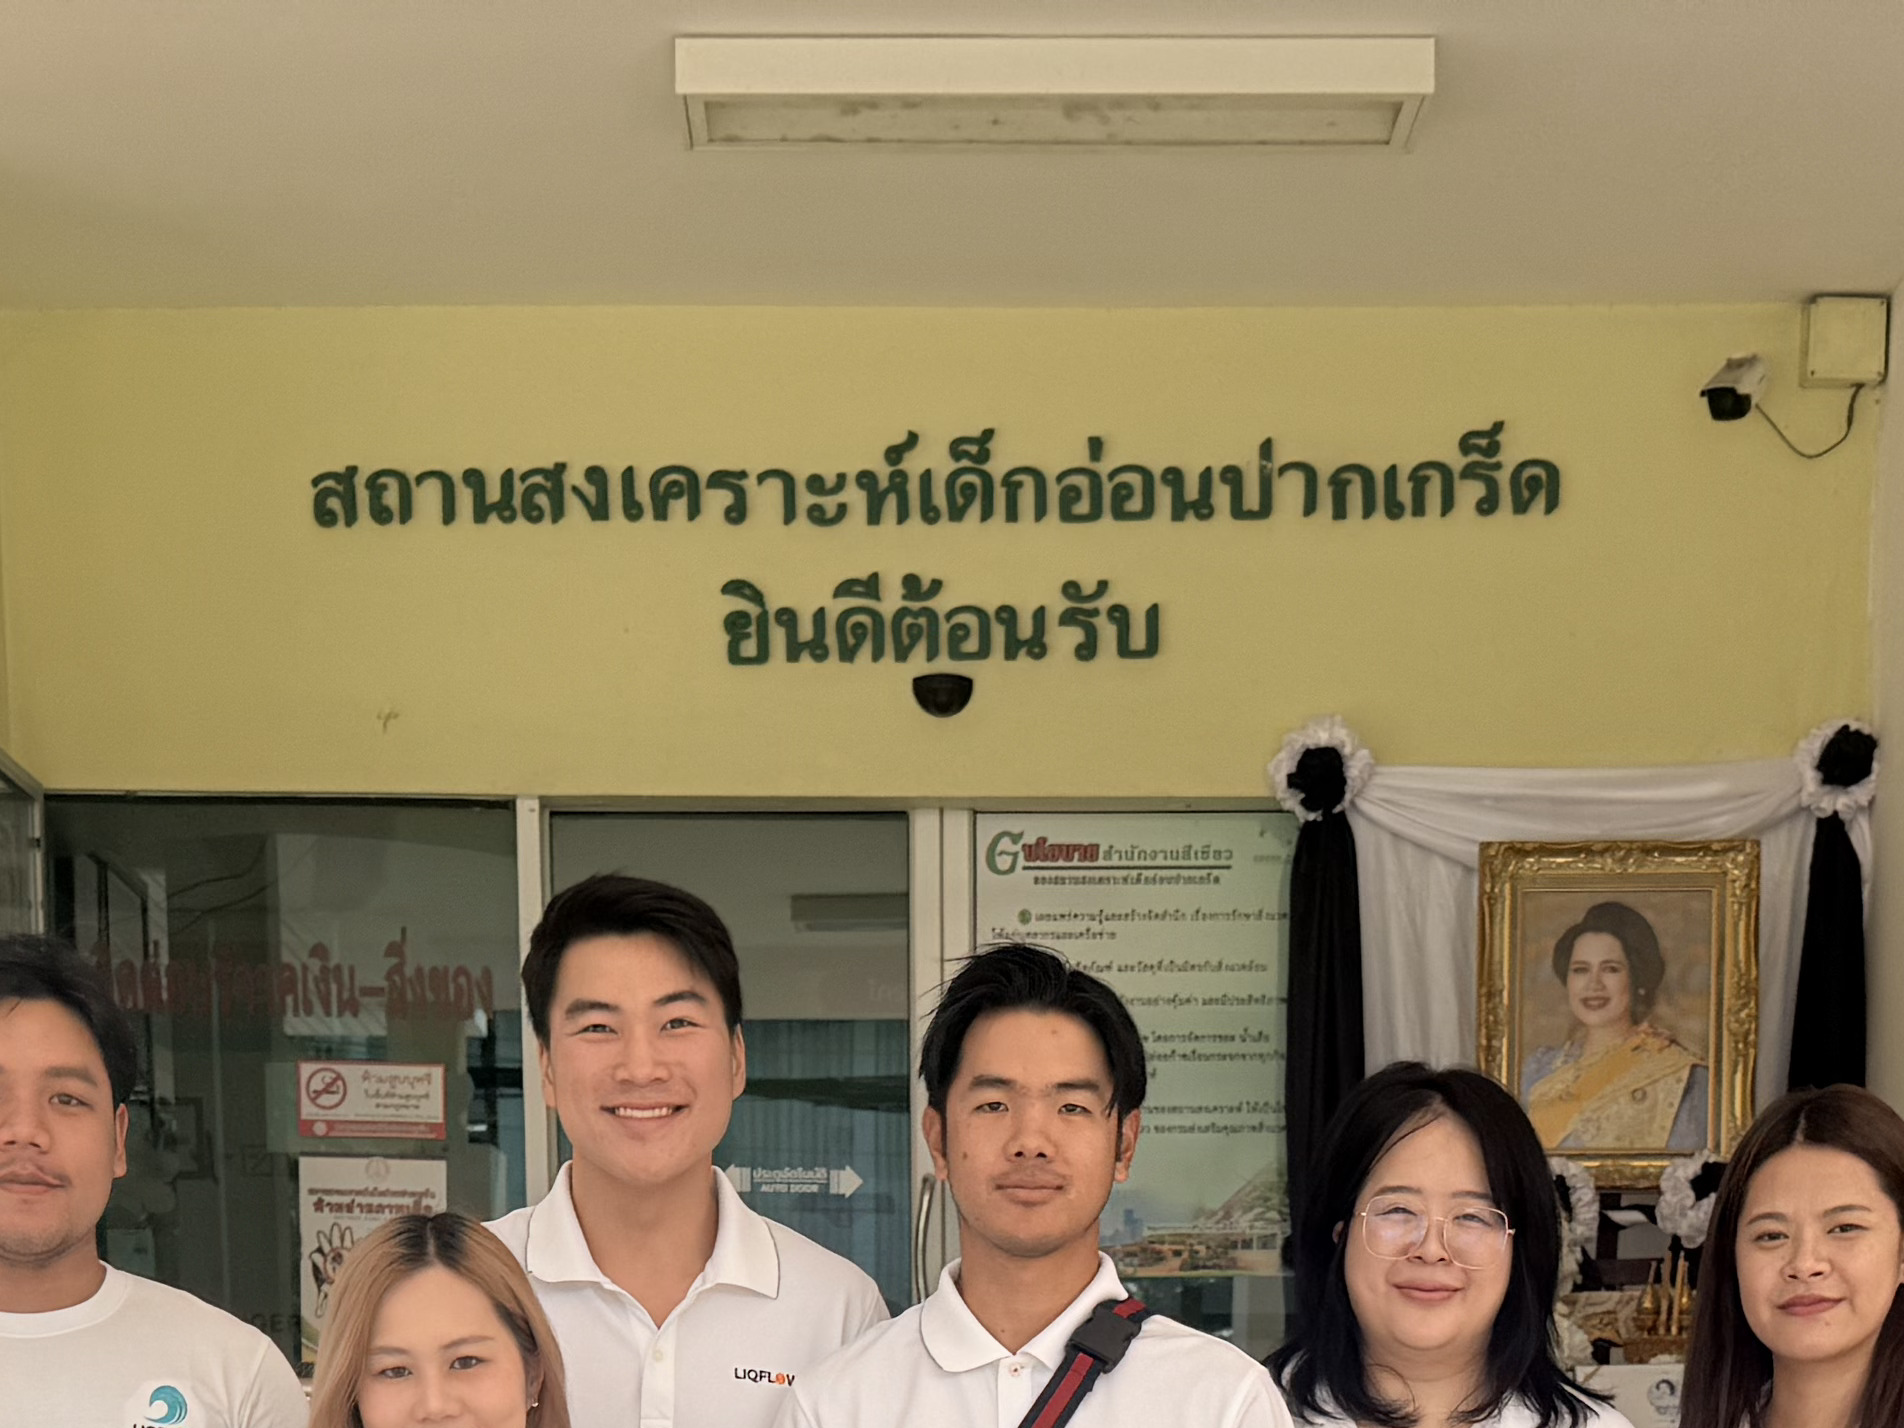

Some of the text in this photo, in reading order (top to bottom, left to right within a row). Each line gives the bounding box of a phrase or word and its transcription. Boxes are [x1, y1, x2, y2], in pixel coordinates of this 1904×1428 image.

[311, 423, 1562, 528] สถานสงเคราะห์เด็กอ่อนปากเกร็ด
[722, 574, 1162, 665] ยินดีต้อนรับ
[1103, 844, 1233, 861] สำนักงานสีเขียว
[760, 1184, 819, 1192] AUTO DOOR
